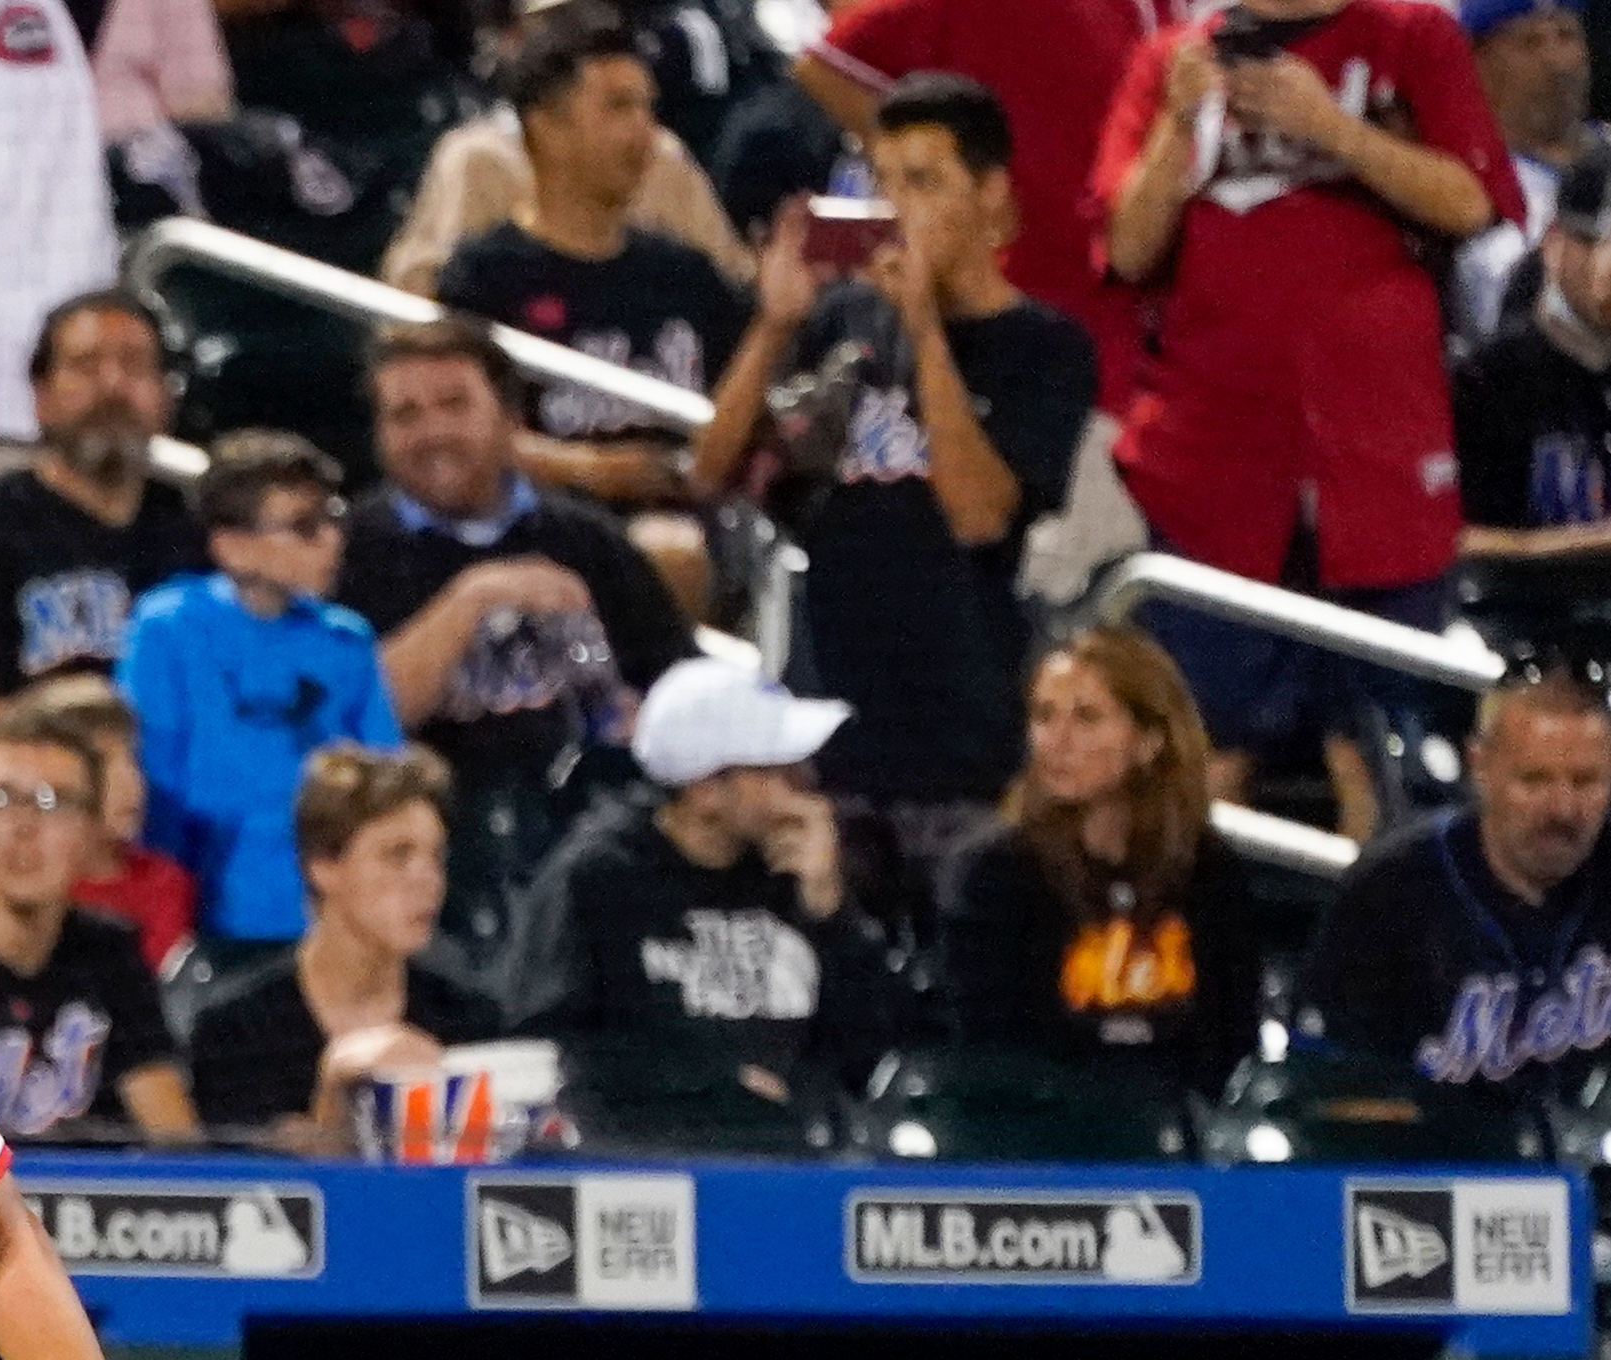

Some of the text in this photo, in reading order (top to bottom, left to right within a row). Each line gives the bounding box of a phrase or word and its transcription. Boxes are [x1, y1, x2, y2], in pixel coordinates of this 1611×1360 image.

[598, 1209, 676, 1244] NEW
[864, 1206, 1097, 1267] MLB.com
[1473, 1215, 1551, 1249] NEW
